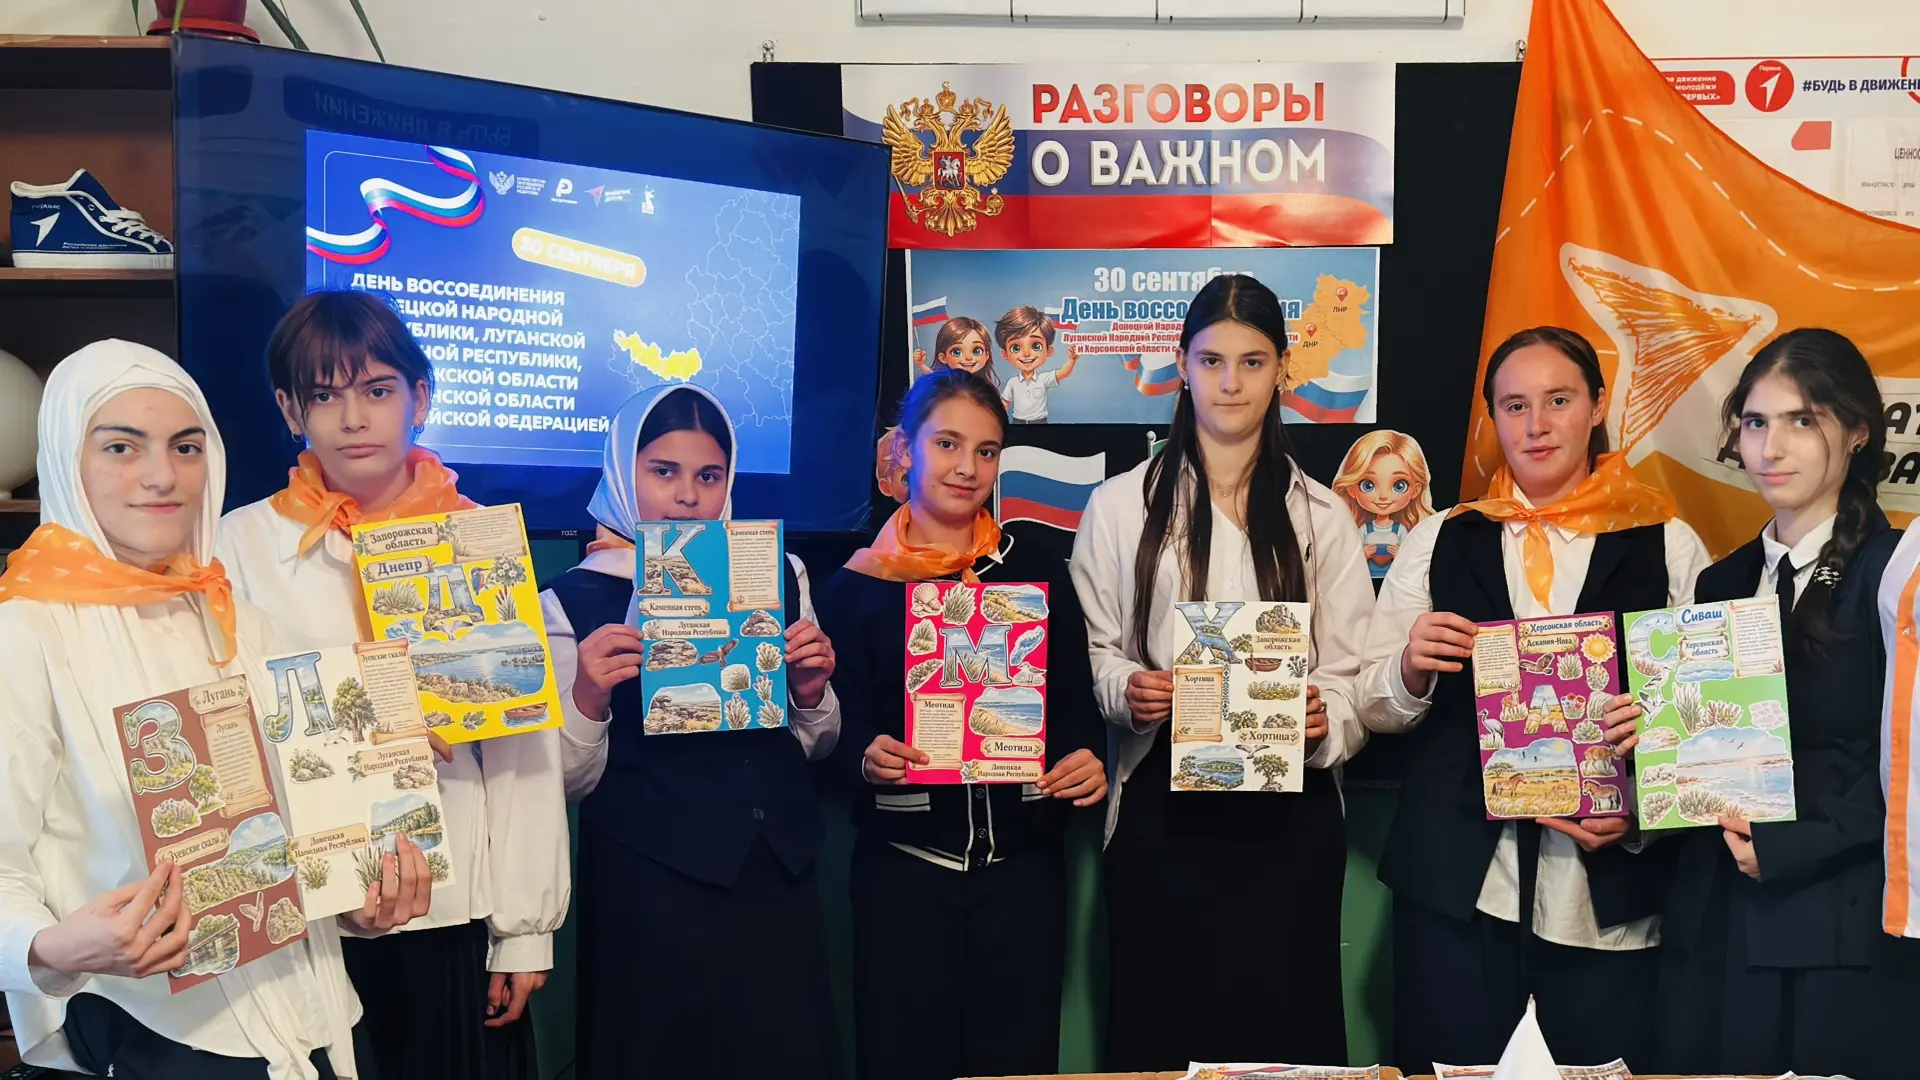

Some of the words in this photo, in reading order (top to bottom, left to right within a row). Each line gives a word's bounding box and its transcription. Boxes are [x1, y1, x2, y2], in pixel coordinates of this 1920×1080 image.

[1802, 79, 1846, 94] #БУДЬ
[1849, 80, 1859, 91] В
[1032, 82, 1324, 124] РАЗГОВОРЫ
[1032, 139, 1070, 187] О
[1089, 138, 1326, 187] ВАЖНОМ
[520, 235, 543, 256] 30
[546, 242, 637, 279] СЕНТЯБРЯ
[1094, 267, 1126, 292] 30
[350, 272, 404, 291] ДЕНЬ
[406, 277, 565, 306] ВОССОЕДИНЕНИЯ
[398, 298, 459, 319] ЕЦКОЙ
[461, 303, 564, 327] НАРОДНОЙ
[1062, 298, 1119, 322] День
[1112, 322, 1154, 332] Донецкой
[1155, 322, 1183, 331] Народ
[405, 321, 480, 344] БЛИКИ,
[483, 326, 587, 349] ЛУГАНСКОЙ
[1063, 333, 1108, 342] Луганской
[1109, 333, 1151, 343] Народной
[1152, 333, 1180, 343] Респуб
[1085, 345, 1135, 354] Херсонской
[1136, 344, 1172, 353] области
[1302, 340, 1318, 349] ДНР
[462, 347, 583, 372] РЕСПУБЛИКИ,
[497, 370, 579, 390] ОБЛАСТИ
[494, 392, 575, 411] ОБЛАСТИ
[494, 412, 610, 433] ФЕДЕРАЦИЕЙ
[369, 526, 433, 544] Запорожская
[730, 529, 759, 537] Каменная
[385, 537, 426, 551] область
[377, 560, 422, 577] Днепр
[649, 602, 683, 611] Каменная
[684, 603, 702, 612] степь
[1681, 607, 1723, 624] Сиваш
[662, 629, 692, 637] Народная
[678, 622, 710, 630] Луганская
[1530, 622, 1573, 634] Херсонская
[1574, 619, 1603, 629] область
[1255, 636, 1301, 645] Запорожская
[1265, 643, 1292, 651] область
[1527, 637, 1573, 647] Аскания-Нова
[1685, 638, 1724, 650] Херсонская
[361, 651, 388, 663] Зуевские
[389, 650, 407, 660] скалы
[1691, 648, 1719, 657] область
[1184, 675, 1215, 684] Хортица
[201, 687, 237, 705] Лугань
[924, 701, 955, 709] Меотида
[1249, 732, 1290, 743] Хортица
[994, 741, 1033, 752] Меотида
[377, 749, 410, 761] Луганская
[363, 760, 394, 772] Народная
[396, 754, 429, 768] Республика
[991, 764, 1022, 772] Донецкая
[310, 832, 345, 847] Донецкая
[168, 843, 202, 864] Зуевские
[202, 835, 220, 849] скалы
[294, 844, 327, 859] Народная
[328, 836, 367, 851] Республика
